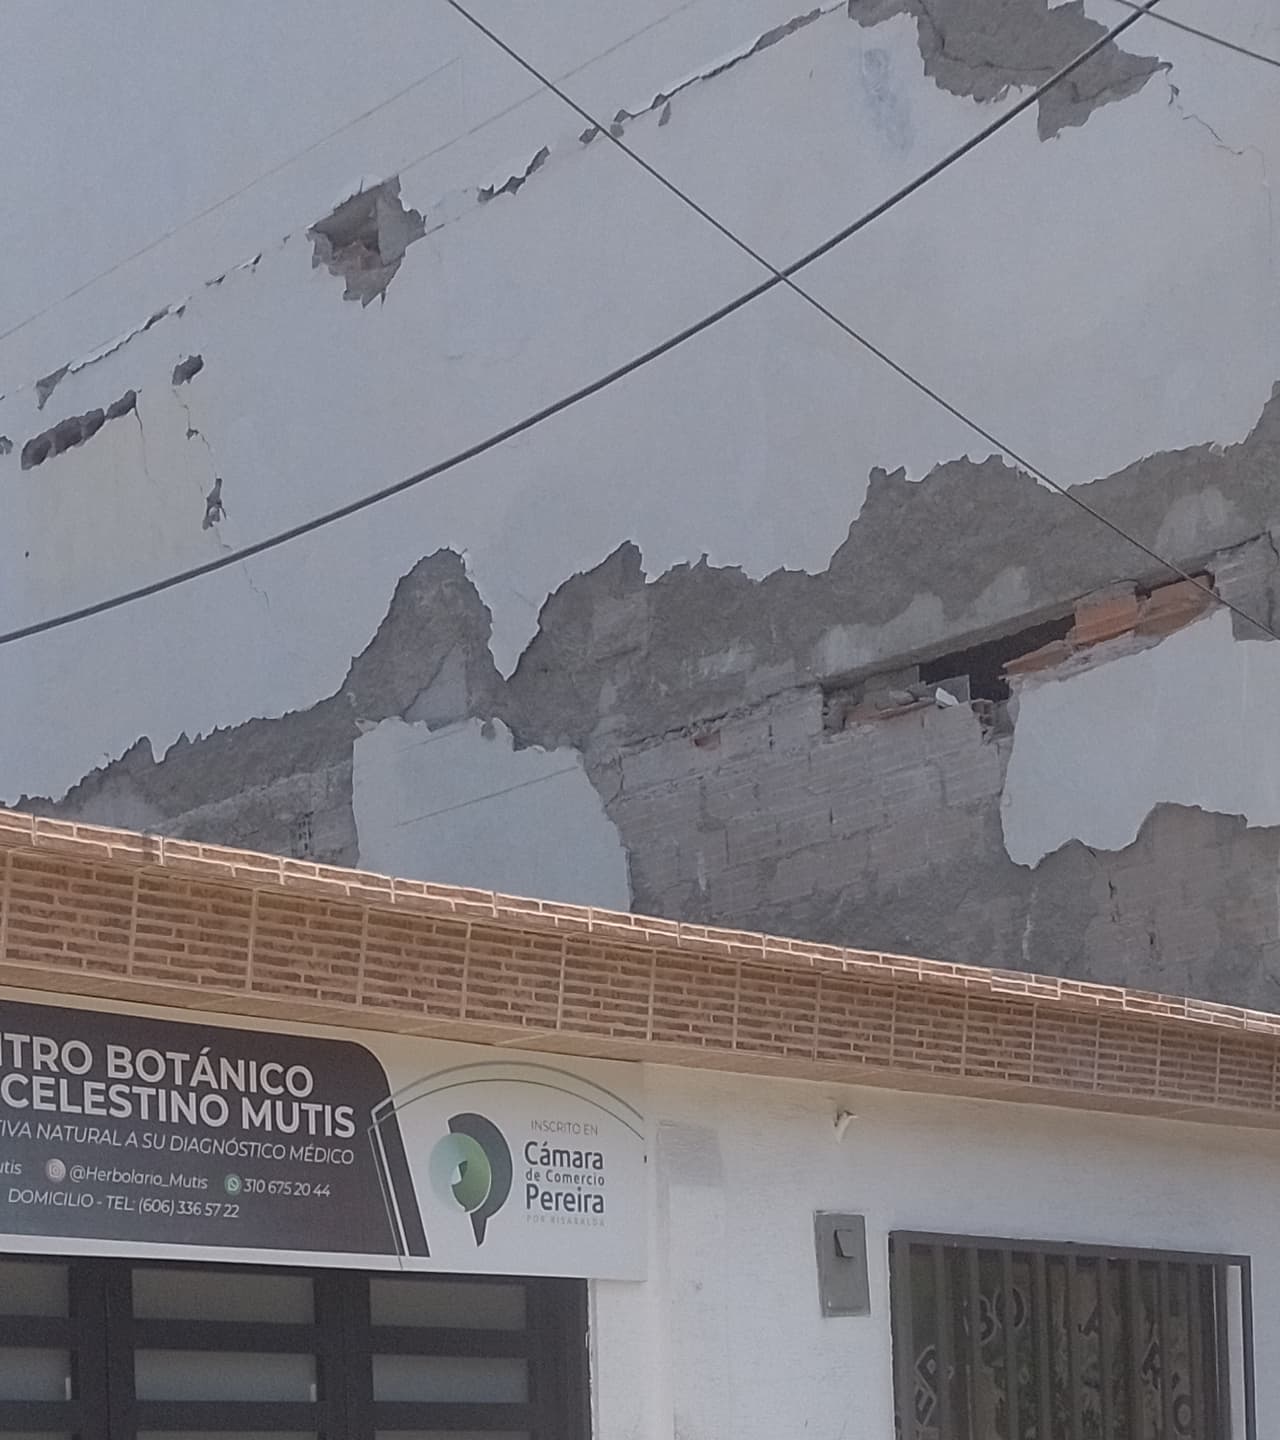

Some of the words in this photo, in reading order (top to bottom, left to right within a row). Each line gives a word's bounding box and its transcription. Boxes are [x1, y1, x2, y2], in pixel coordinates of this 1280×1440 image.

[106, 1044, 314, 1098] BOTÁNICO
[0, 1072, 230, 1127] CELESTINO
[241, 1097, 356, 1138] MUTIS
[530, 1119, 581, 1135] INSCRITO
[583, 1123, 598, 1136] EN
[36, 1124, 121, 1147] NATURAL
[125, 1132, 138, 1148] A
[142, 1132, 166, 1150] SU
[170, 1135, 286, 1160] DIAGNÓSTICO
[289, 1143, 355, 1165] MÉDICO
[524, 1140, 603, 1170] Cámara
[70, 1164, 209, 1190] @Herbolario_Mutis
[243, 1178, 266, 1194] 310
[268, 1180, 292, 1195] 675
[294, 1181, 311, 1196] 20
[313, 1182, 331, 1197] 44
[525, 1167, 541, 1182] de
[545, 1169, 605, 1186] Comercio
[8, 1188, 94, 1208] DOMICILIO
[137, 1198, 175, 1216] (606)
[177, 1200, 202, 1216] 336
[204, 1202, 221, 1217] 57
[223, 1203, 240, 1218] 22
[525, 1183, 605, 1214] Pereira
